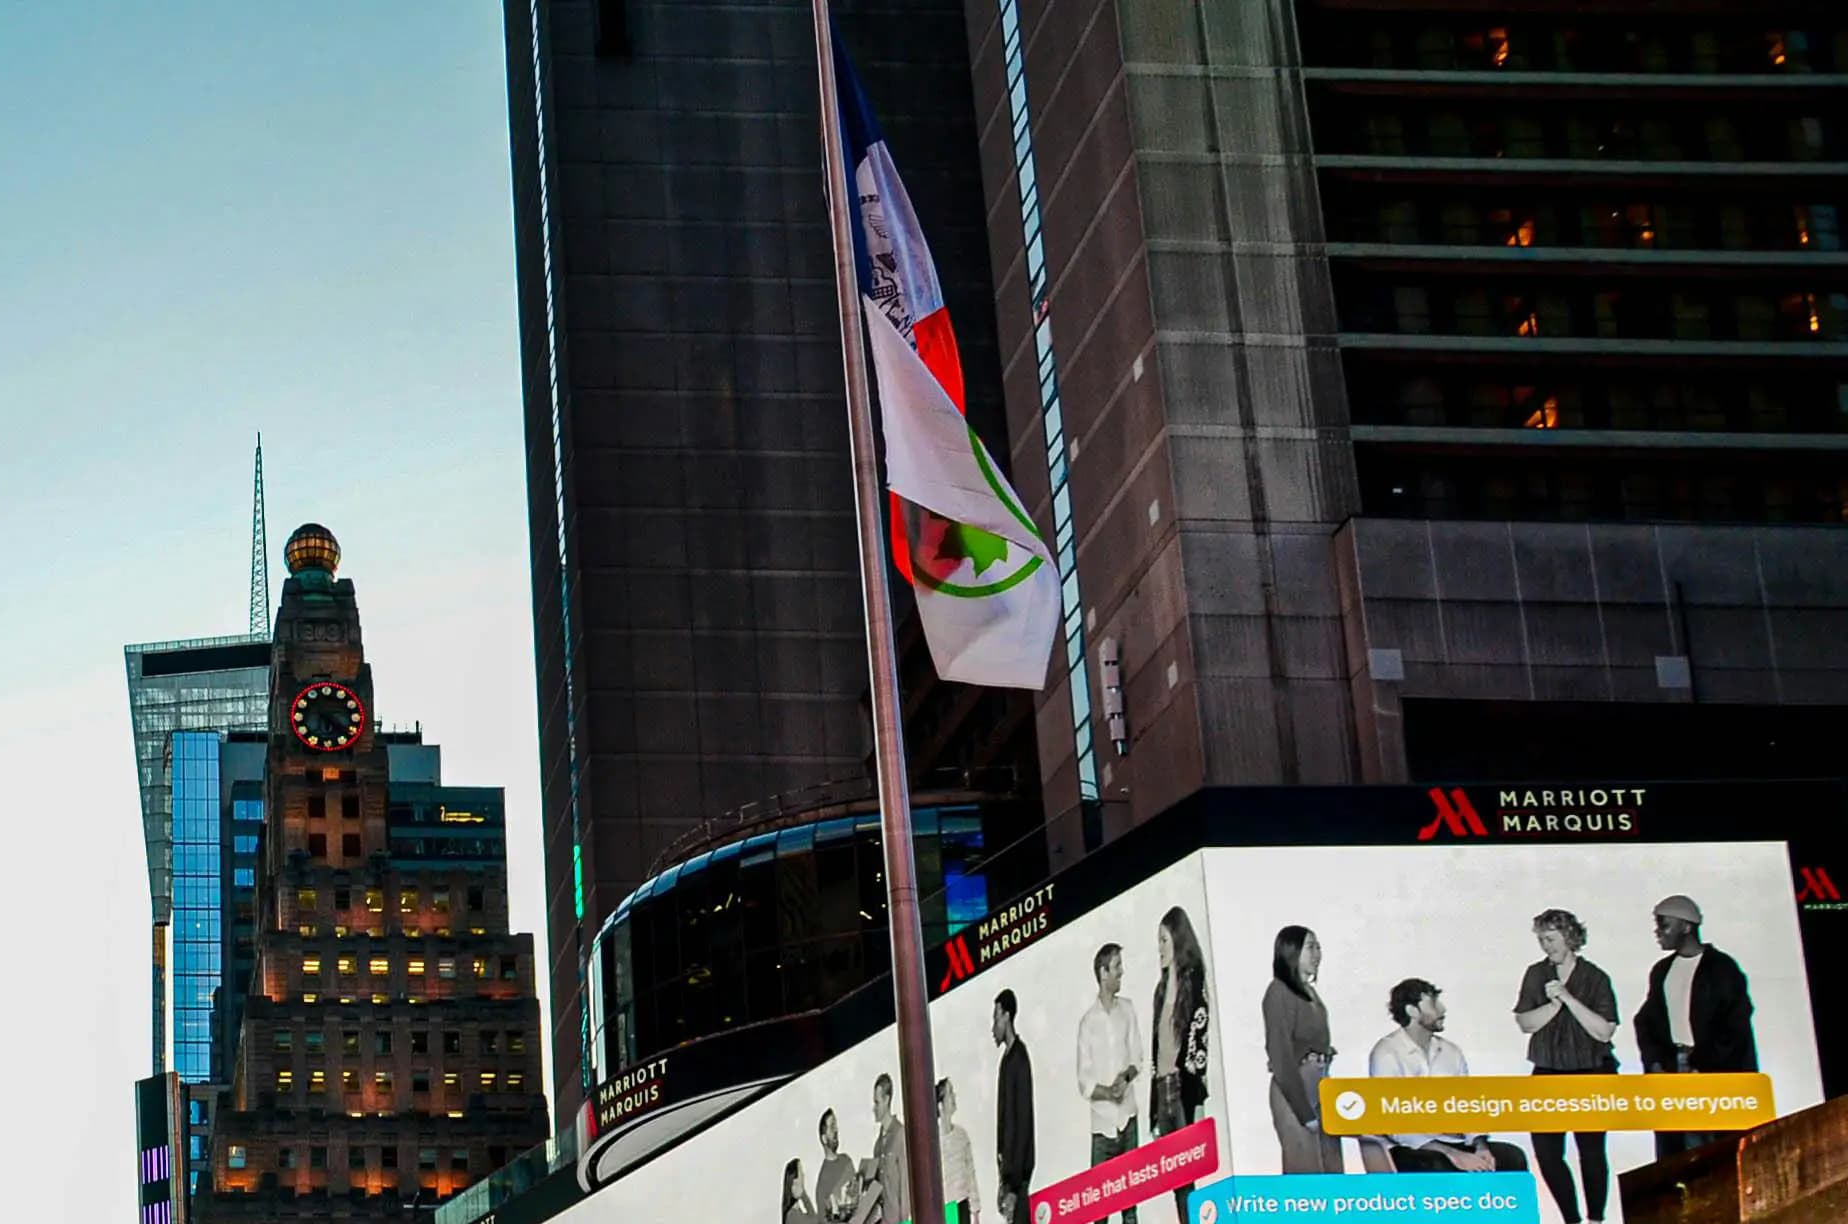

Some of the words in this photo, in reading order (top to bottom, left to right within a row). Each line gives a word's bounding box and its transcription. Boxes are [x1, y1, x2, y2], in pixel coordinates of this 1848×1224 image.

[1499, 788, 1647, 808] MARRIOTT
[1503, 813, 1633, 832] MARQUIS
[978, 884, 1055, 940] MARRIOTT
[979, 913, 1048, 963] MARQUIS
[599, 1058, 669, 1101] MARRIOTT
[600, 1084, 660, 1127] MARQUIS
[1381, 1095, 1436, 1115] Make
[1442, 1094, 1513, 1119] design
[1519, 1093, 1628, 1114] accessible
[1634, 1094, 1655, 1113] to
[1660, 1094, 1758, 1116] everyone
[1057, 1193, 1080, 1218] Sell
[1102, 1177, 1126, 1203] that
[1127, 1163, 1158, 1194] lasts
[1159, 1141, 1207, 1183] forever
[1226, 1192, 1279, 1214] Write
[1284, 1196, 1327, 1212] new
[1332, 1191, 1416, 1217] product
[1422, 1194, 1472, 1215] spec
[1477, 1191, 1518, 1210] doc
